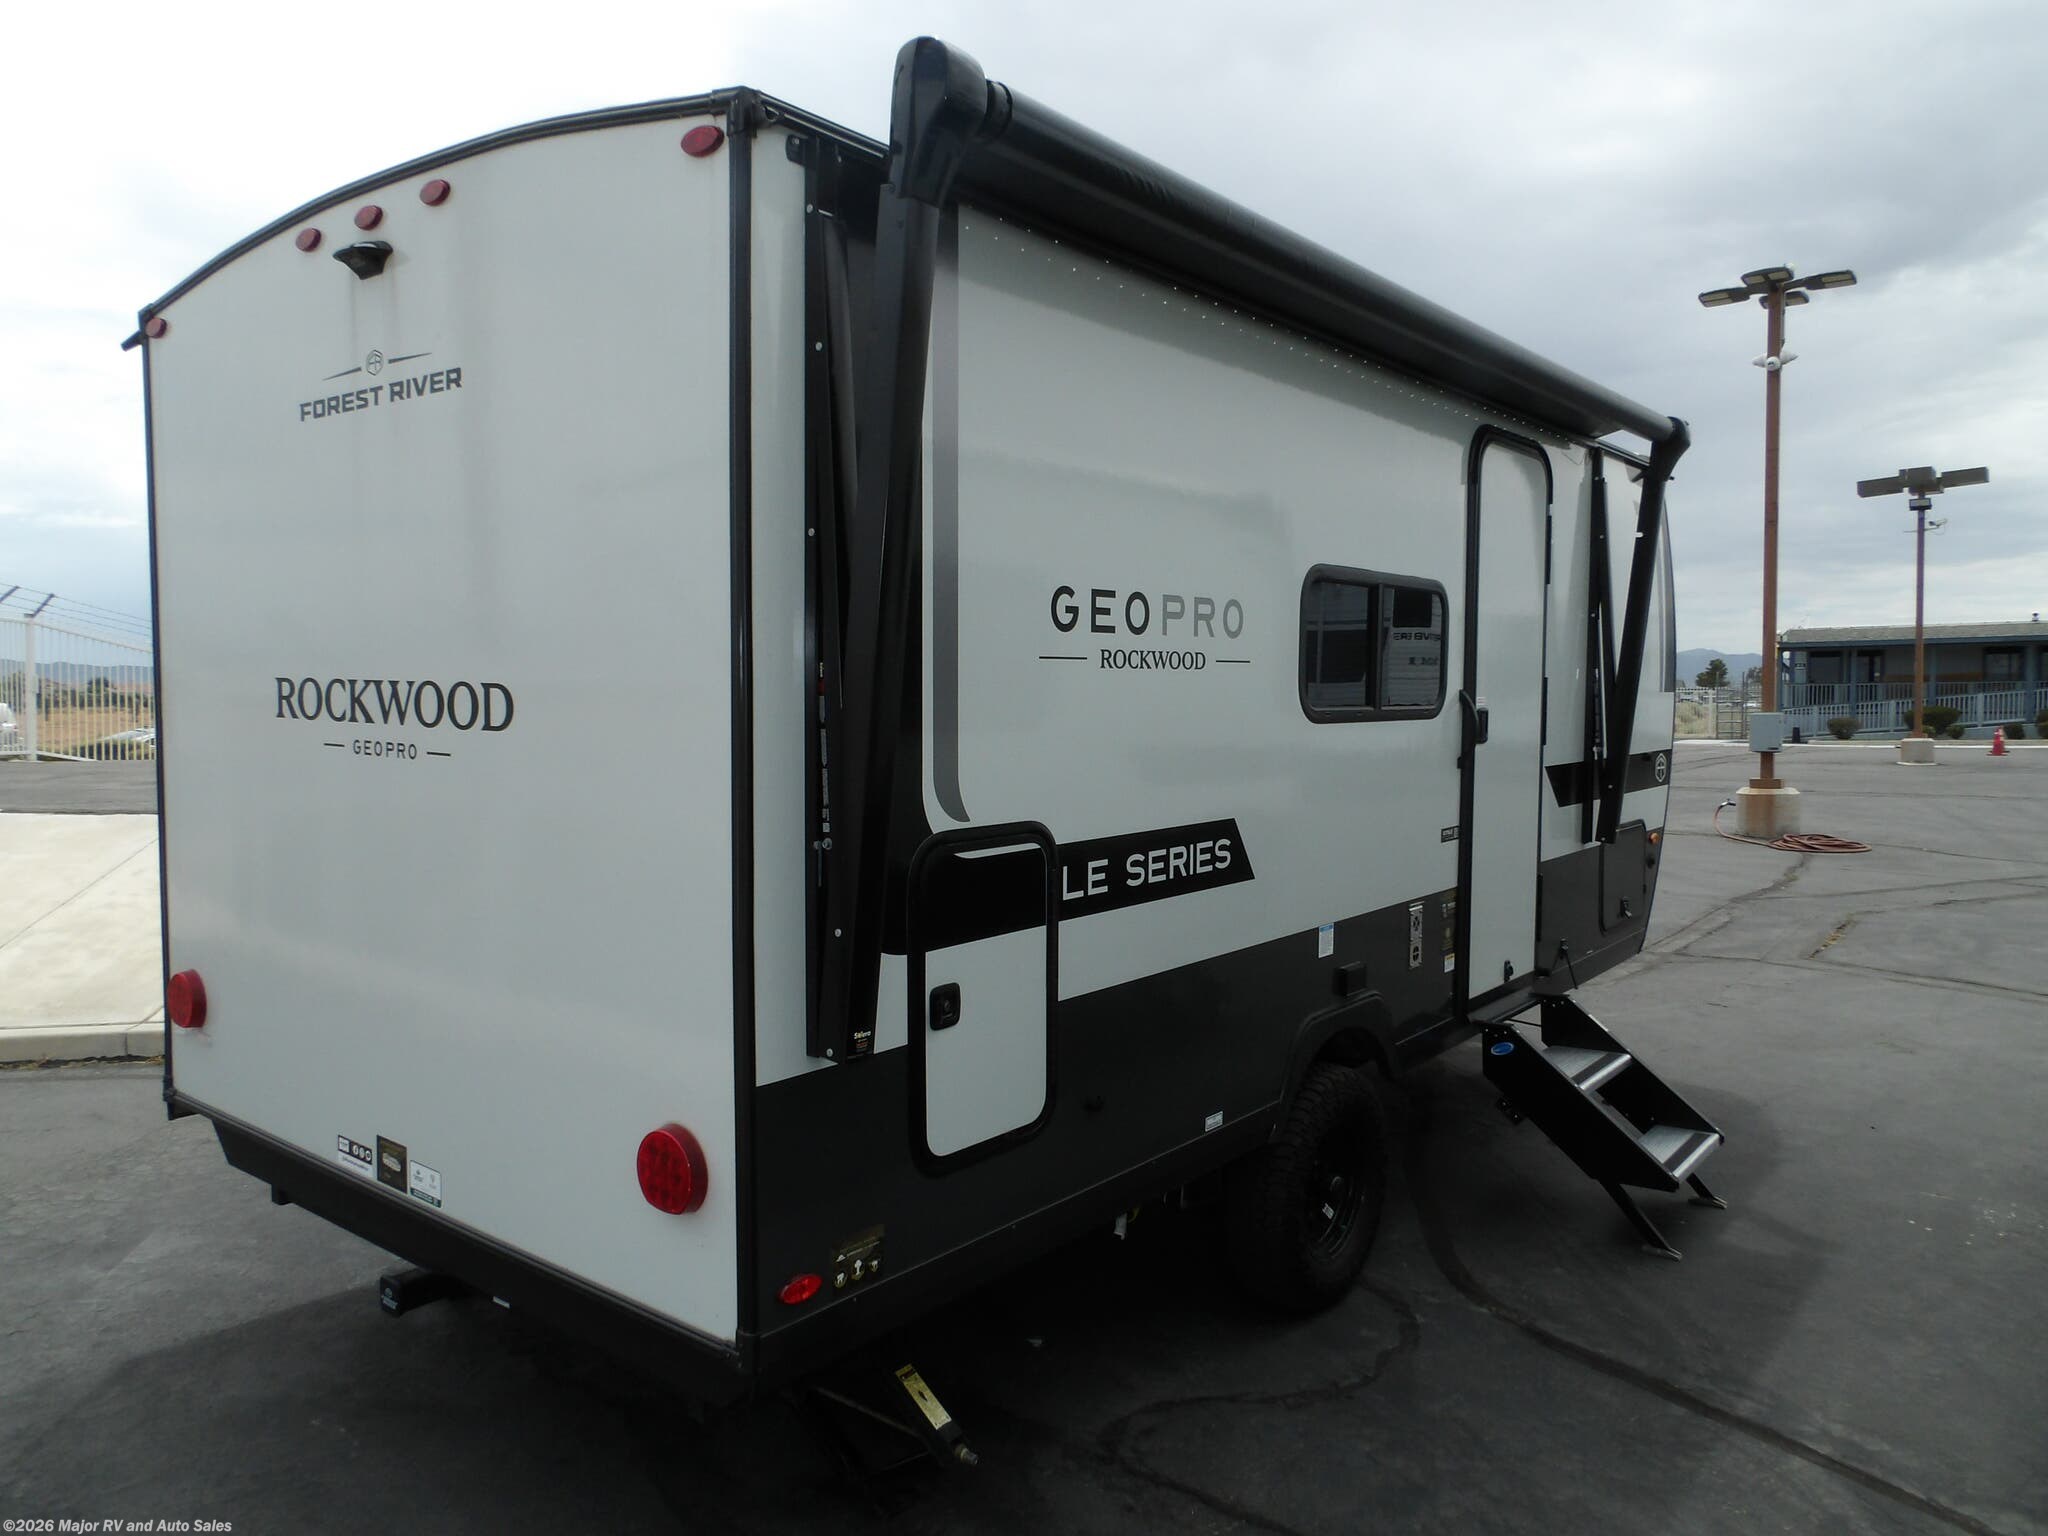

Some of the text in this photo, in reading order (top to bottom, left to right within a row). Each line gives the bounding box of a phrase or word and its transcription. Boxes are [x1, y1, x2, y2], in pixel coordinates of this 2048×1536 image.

[299, 367, 463, 422] FOREST RIVER
[1050, 585, 1245, 639] GEOPRO
[1099, 648, 1207, 670] ROCKWOOD
[275, 677, 515, 732] ROCKWOOD
[352, 739, 418, 760] GEOPRO
[1062, 838, 1232, 901] LE SERIES
